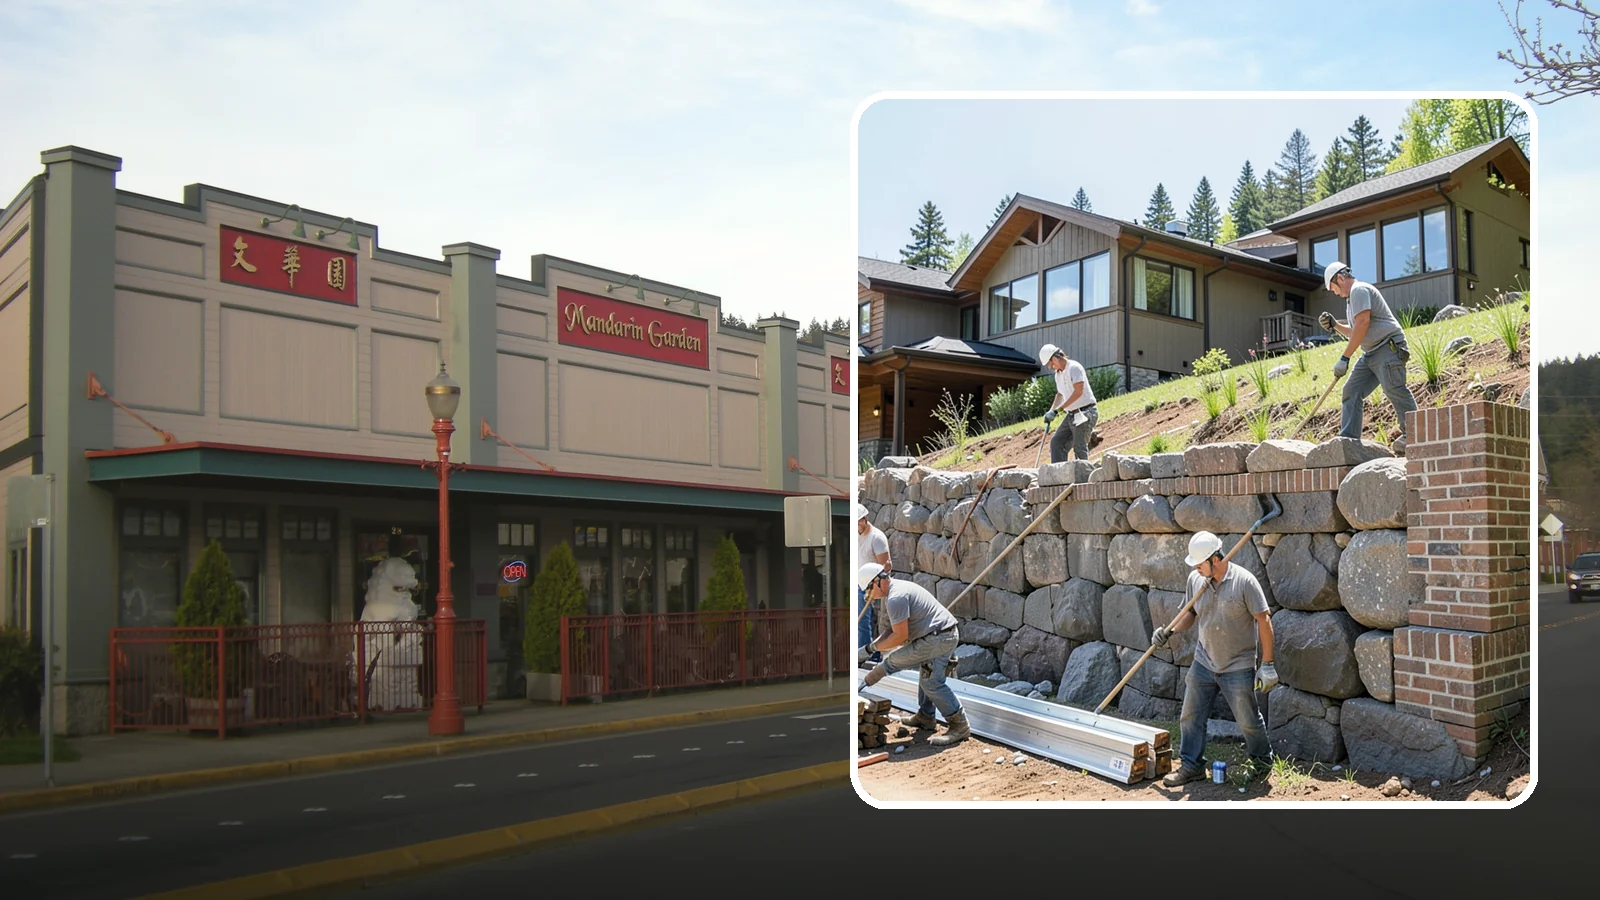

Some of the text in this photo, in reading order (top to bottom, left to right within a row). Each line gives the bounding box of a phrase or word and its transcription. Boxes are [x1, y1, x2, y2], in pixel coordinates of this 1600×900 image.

[564, 302, 701, 352] Mandarin Garden
[503, 565, 527, 578] OPEN
